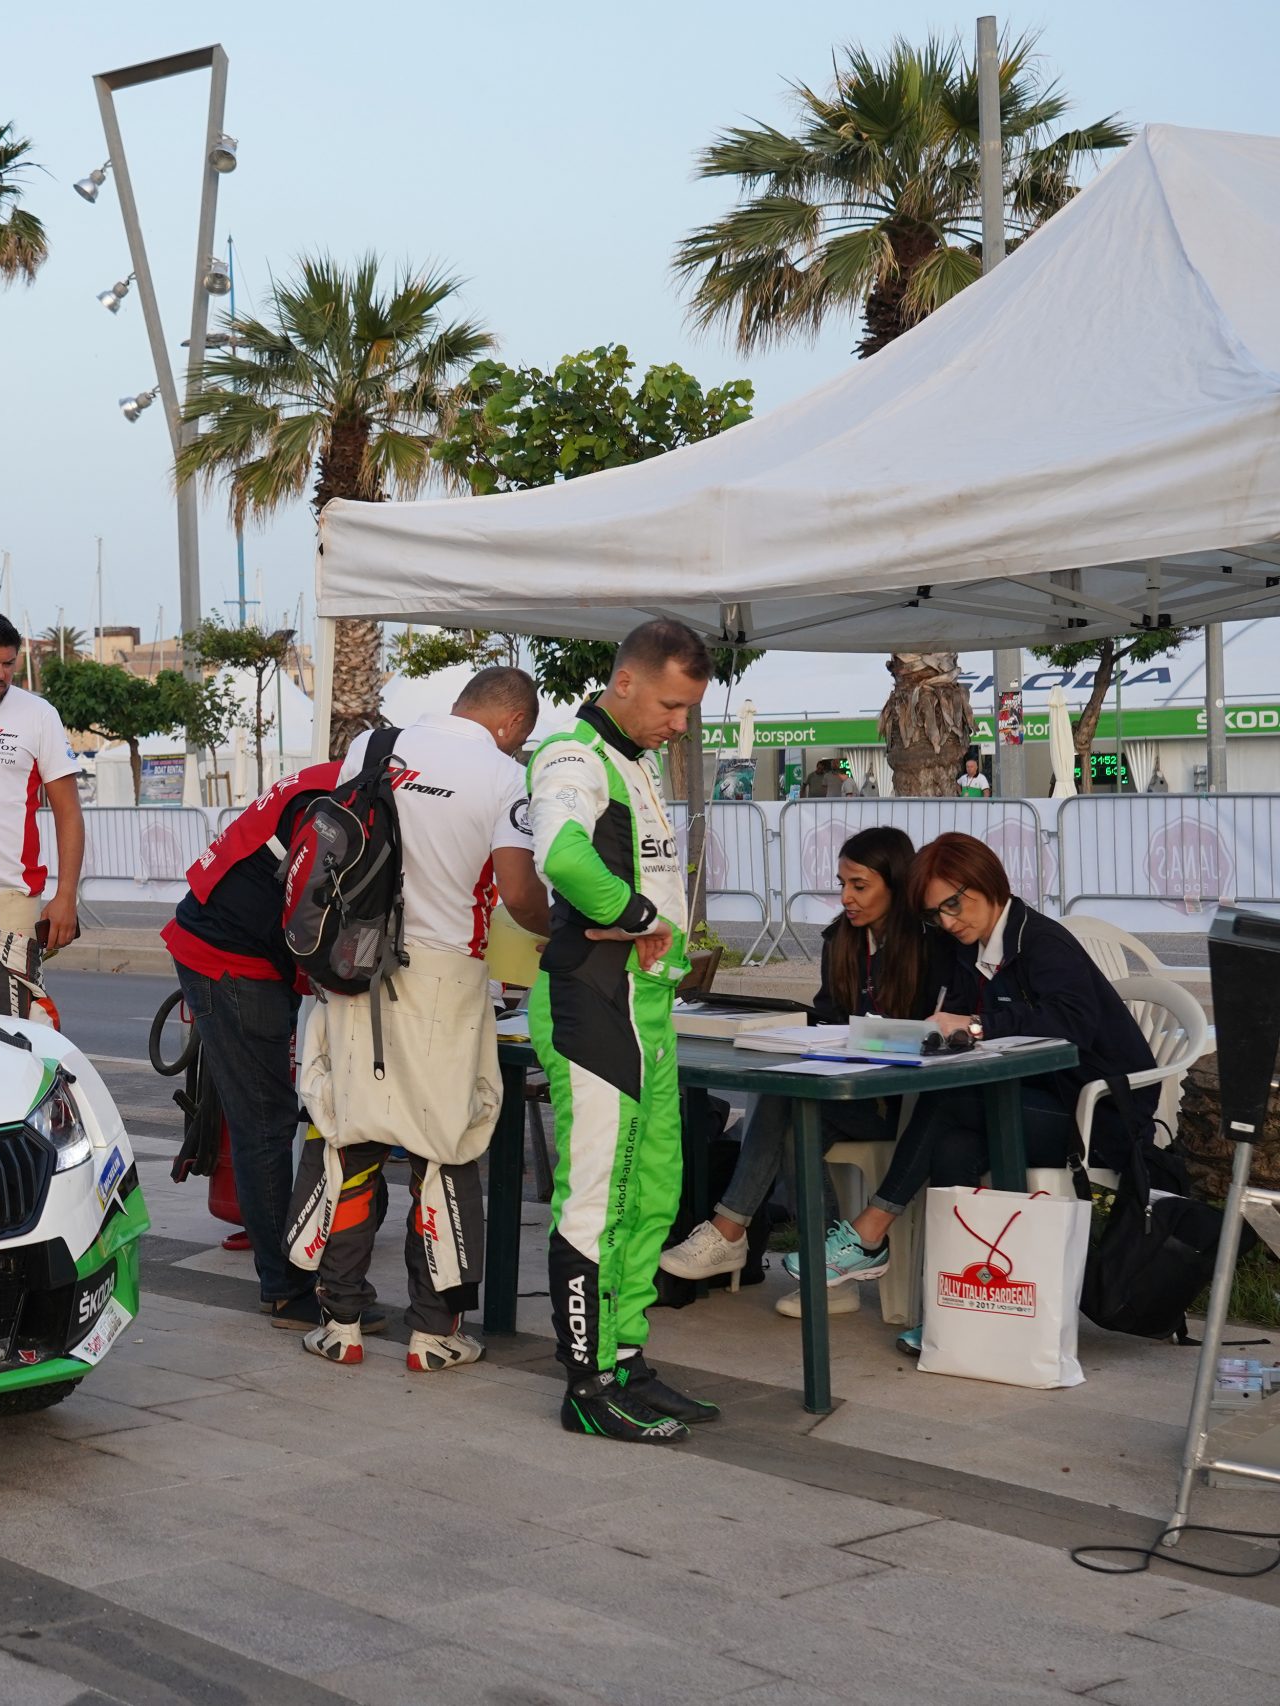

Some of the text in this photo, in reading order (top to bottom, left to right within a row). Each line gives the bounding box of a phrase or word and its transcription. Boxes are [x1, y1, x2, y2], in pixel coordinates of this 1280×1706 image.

[1197, 709, 1280, 729] ŠKOD
[733, 727, 816, 746] Mtorsport
[399, 782, 456, 799] SPORTS
[285, 845, 309, 907] ICEPEAK
[321, 1197, 333, 1239] SPORTS
[424, 1230, 439, 1276] SPORTS
[78, 1271, 115, 1324] ŠKODA
[939, 1274, 1034, 1306] RALLY ITALIA SARDEGNA
[976, 1301, 996, 1310] 2017
